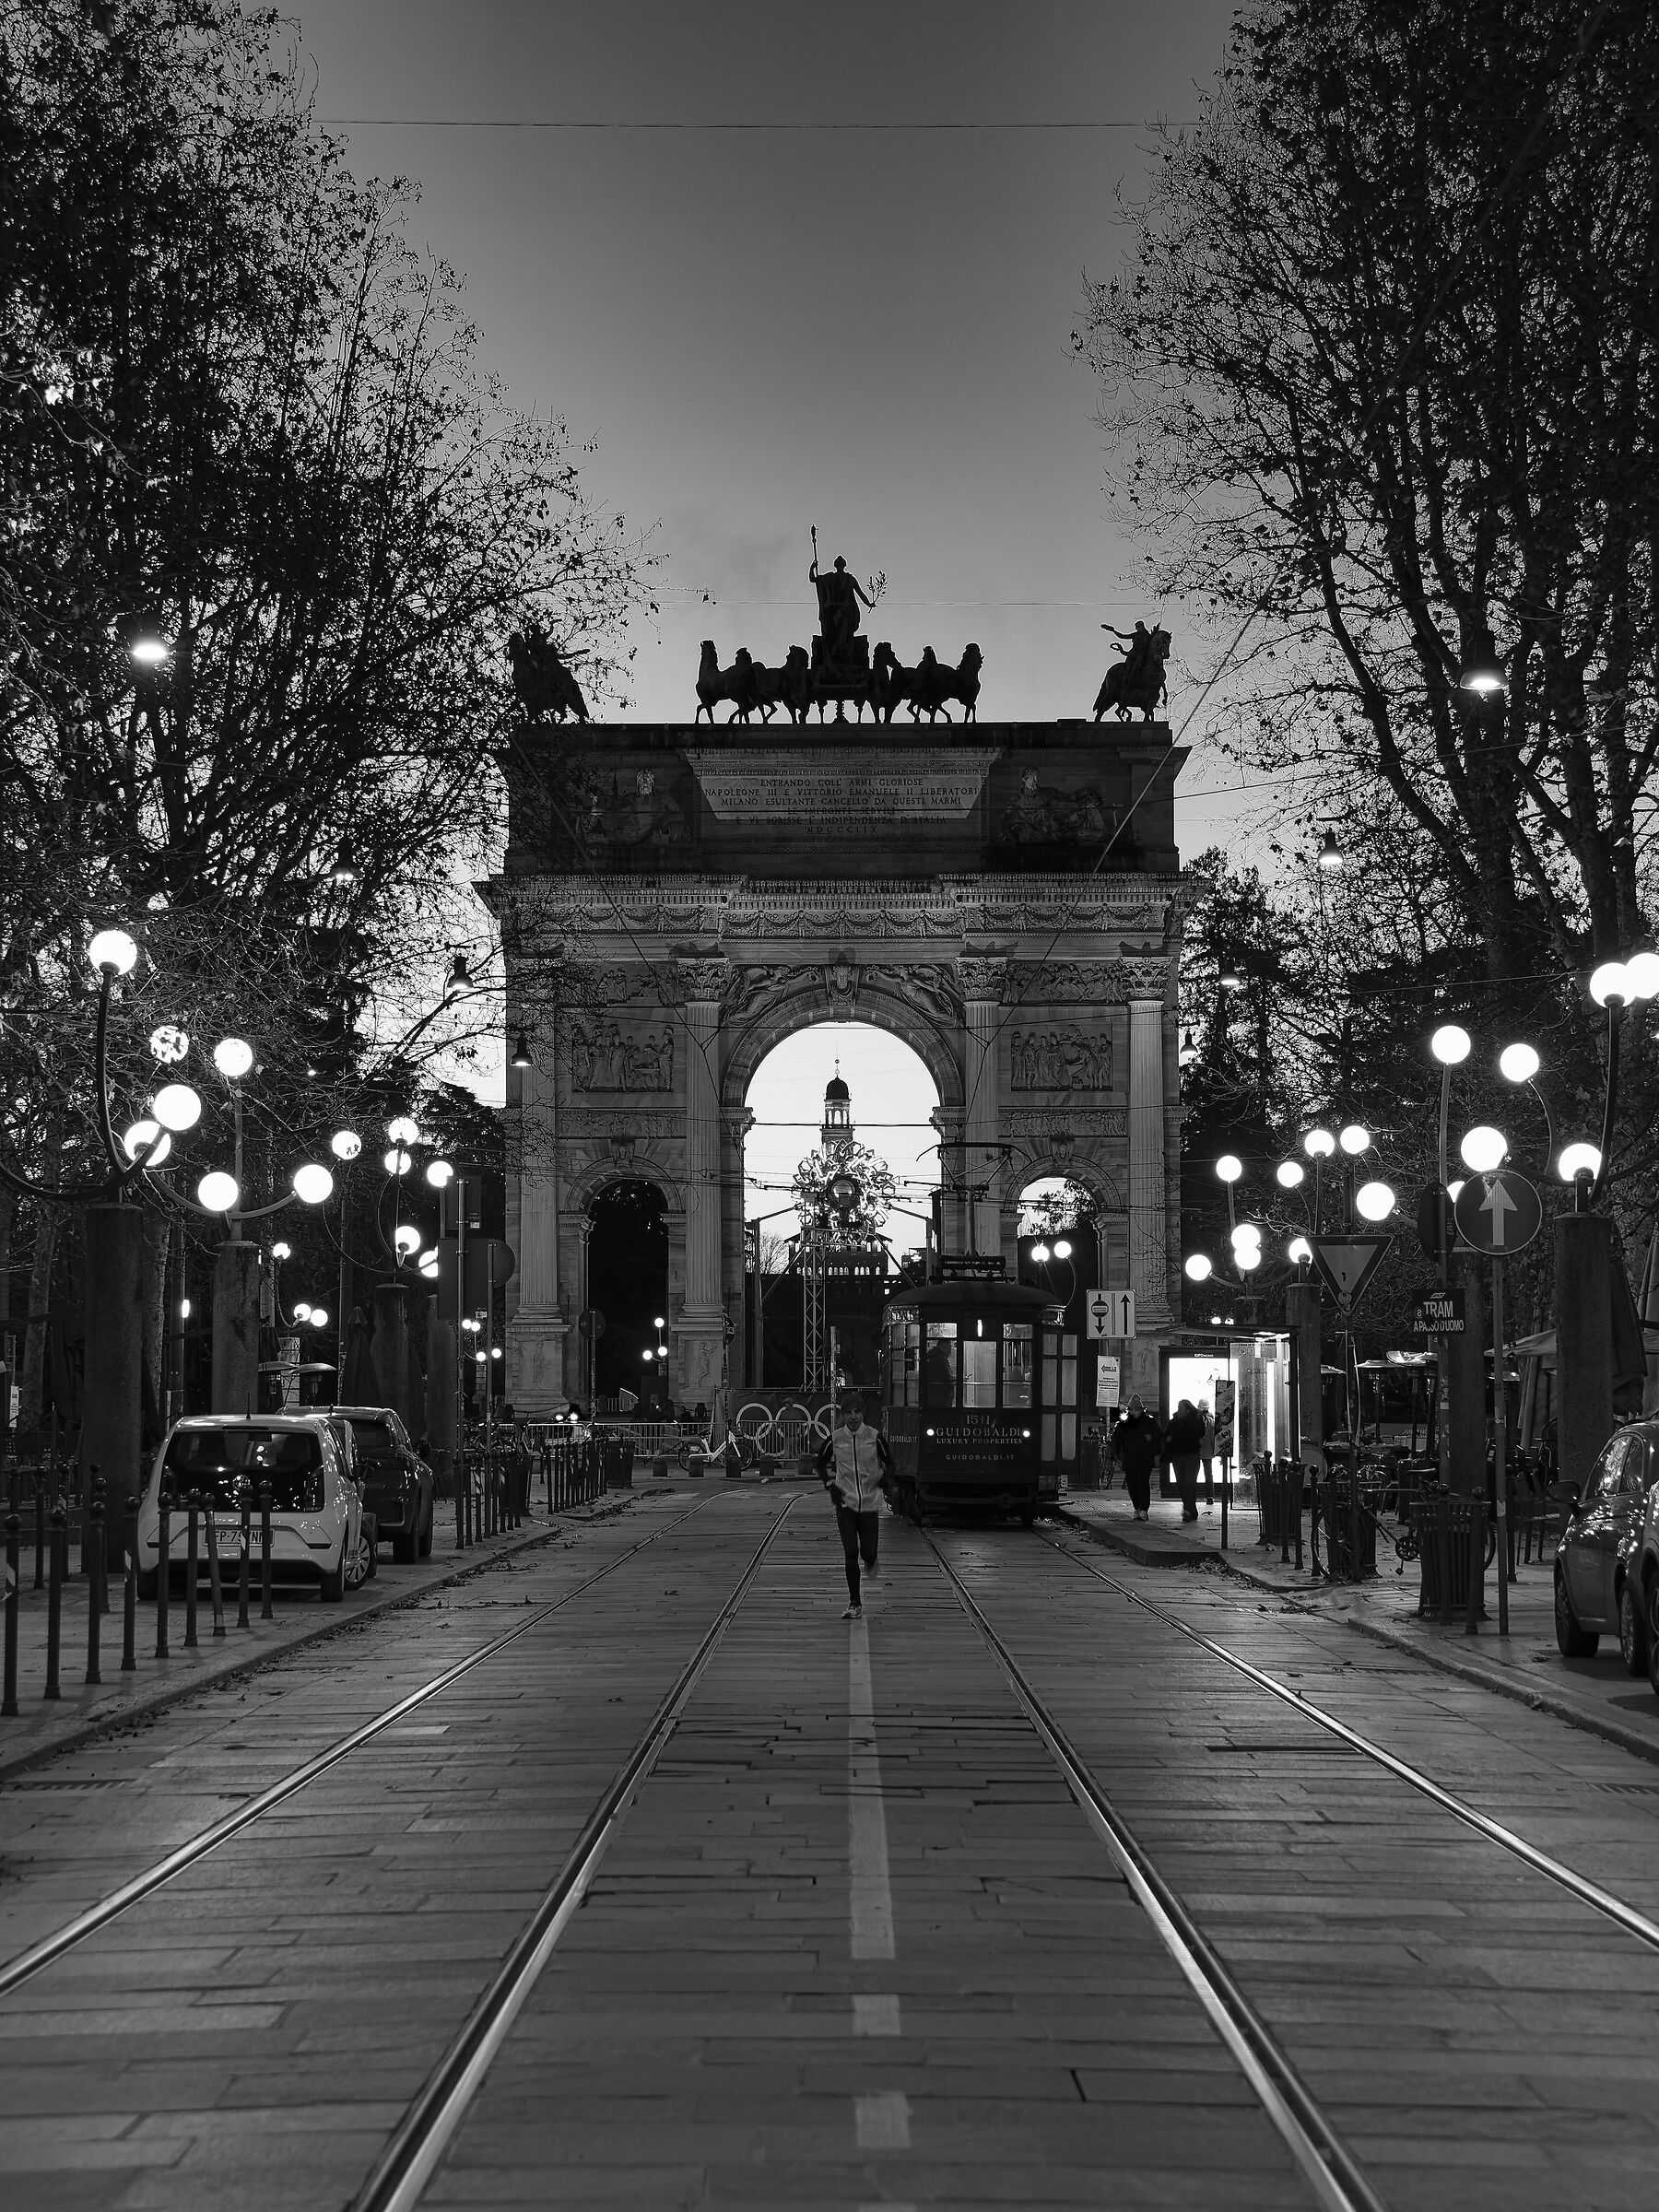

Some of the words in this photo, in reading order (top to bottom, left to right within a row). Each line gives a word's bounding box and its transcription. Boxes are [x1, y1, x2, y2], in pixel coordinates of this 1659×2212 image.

[760, 779, 811, 787] ENTRANDO
[705, 788, 760, 796] NAPOLEONE
[797, 788, 842, 796] VITTORIO
[921, 787, 978, 795] LIBERATORI
[893, 797, 925, 806] QUESTI
[914, 816, 947, 824] ITALIA
[1423, 1300, 1453, 1318] TRAM
[1413, 1320, 1418, 1333] A
[935, 1428, 1021, 1437] GUIDOBALDI
